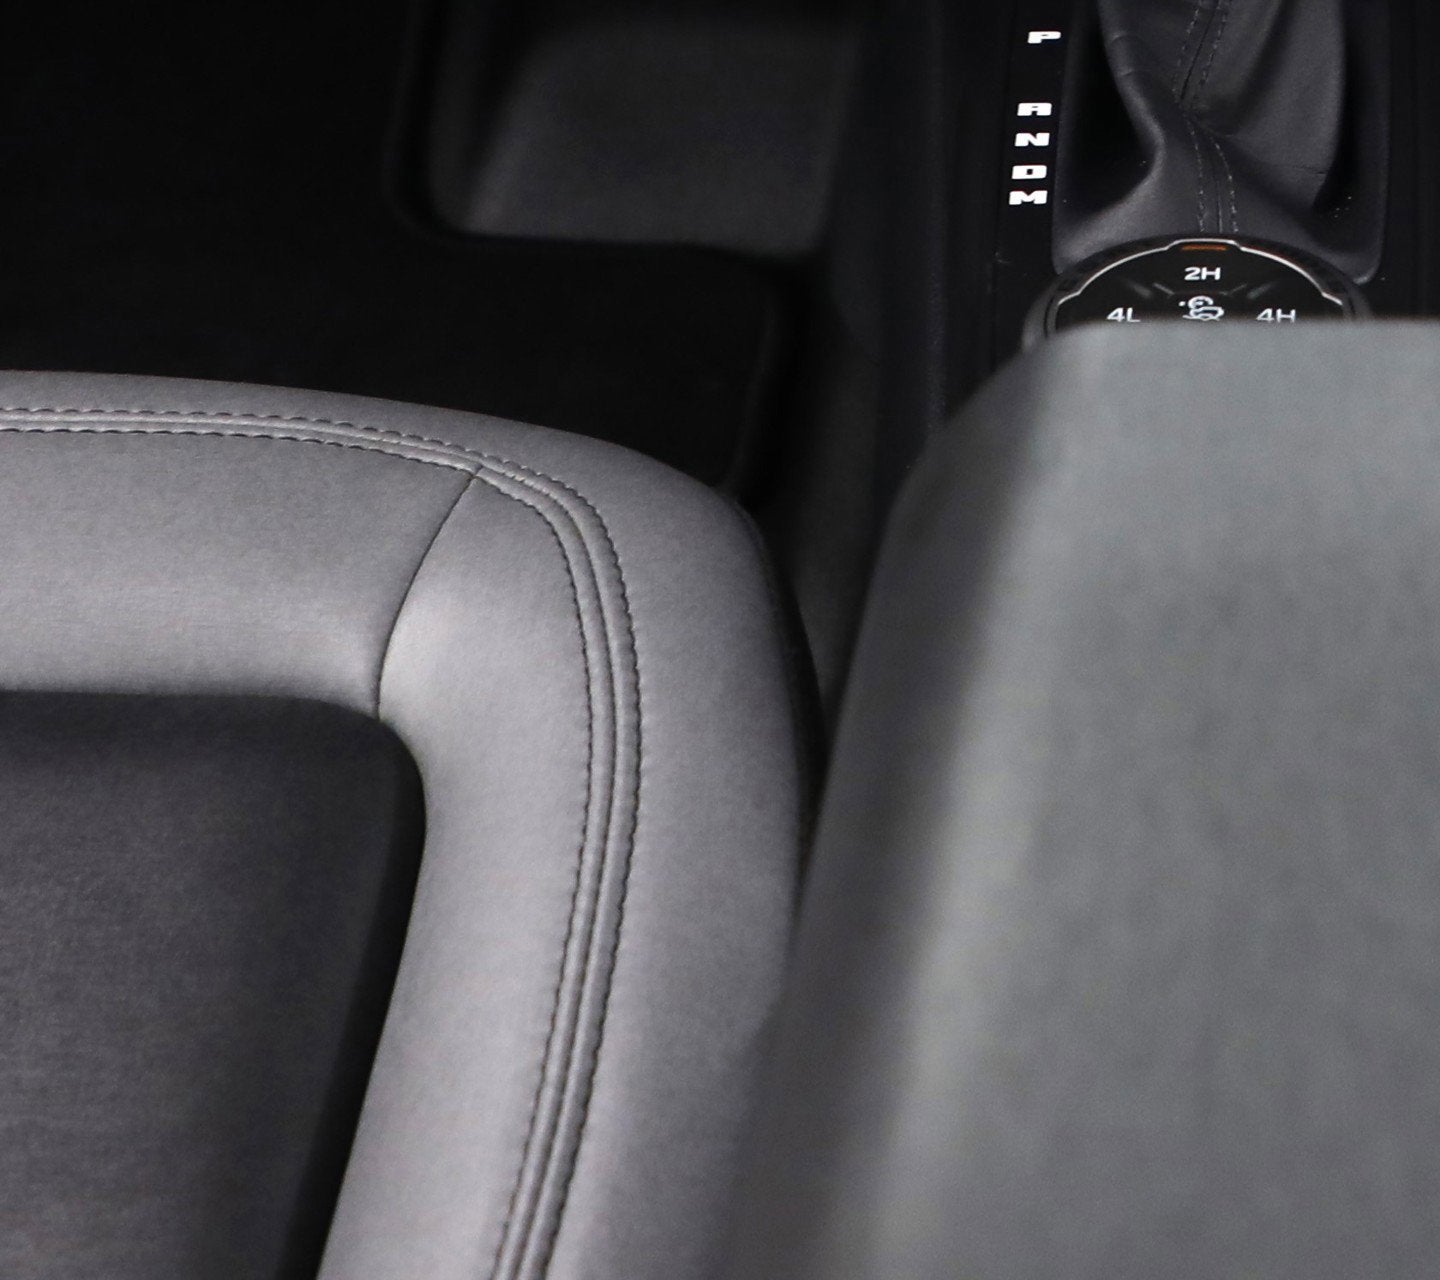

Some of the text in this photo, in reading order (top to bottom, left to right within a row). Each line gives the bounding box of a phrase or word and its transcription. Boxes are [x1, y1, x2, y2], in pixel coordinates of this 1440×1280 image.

[1027, 30, 1062, 44] P
[1014, 132, 1050, 147] N
[1011, 164, 1048, 180] D
[1008, 189, 1048, 206] M
[1184, 266, 1221, 281] 2H
